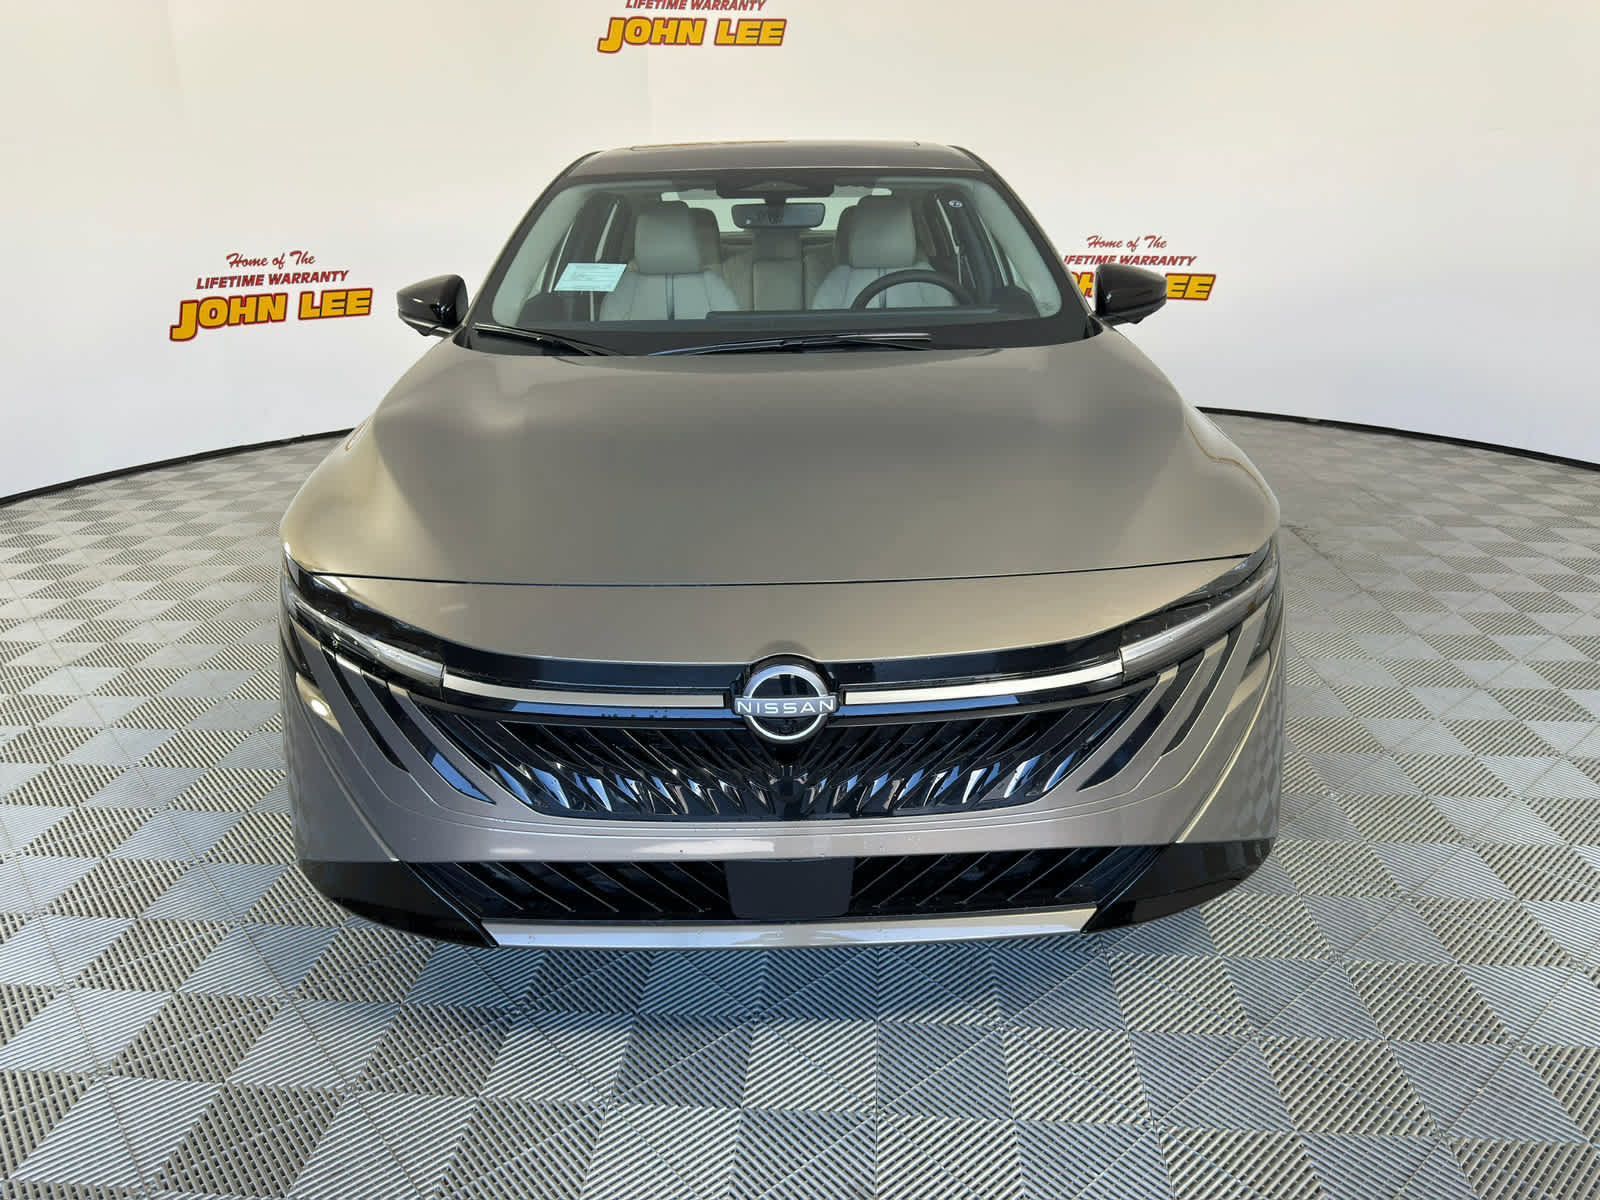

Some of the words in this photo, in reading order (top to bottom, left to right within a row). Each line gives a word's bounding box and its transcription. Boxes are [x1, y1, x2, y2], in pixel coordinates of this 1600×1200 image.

[625, 0, 687, 10] LIFETIME
[690, 0, 766, 11] WARRANTY
[598, 16, 707, 54] JOHN
[714, 18, 787, 46] LEE
[1087, 235, 1123, 249] Home
[1126, 236, 1141, 252] of
[1144, 235, 1168, 249] The
[226, 252, 268, 269] Home
[272, 253, 285, 270] of
[289, 250, 316, 266] The
[1063, 255, 1117, 265] IFETIME
[1119, 255, 1198, 266] WARRANTY
[196, 274, 264, 290] LIFETIME
[267, 270, 349, 285] WARRANTY
[169, 293, 288, 342] JOHN
[298, 288, 373, 320] LEE
[736, 699, 834, 714] NISSAN
